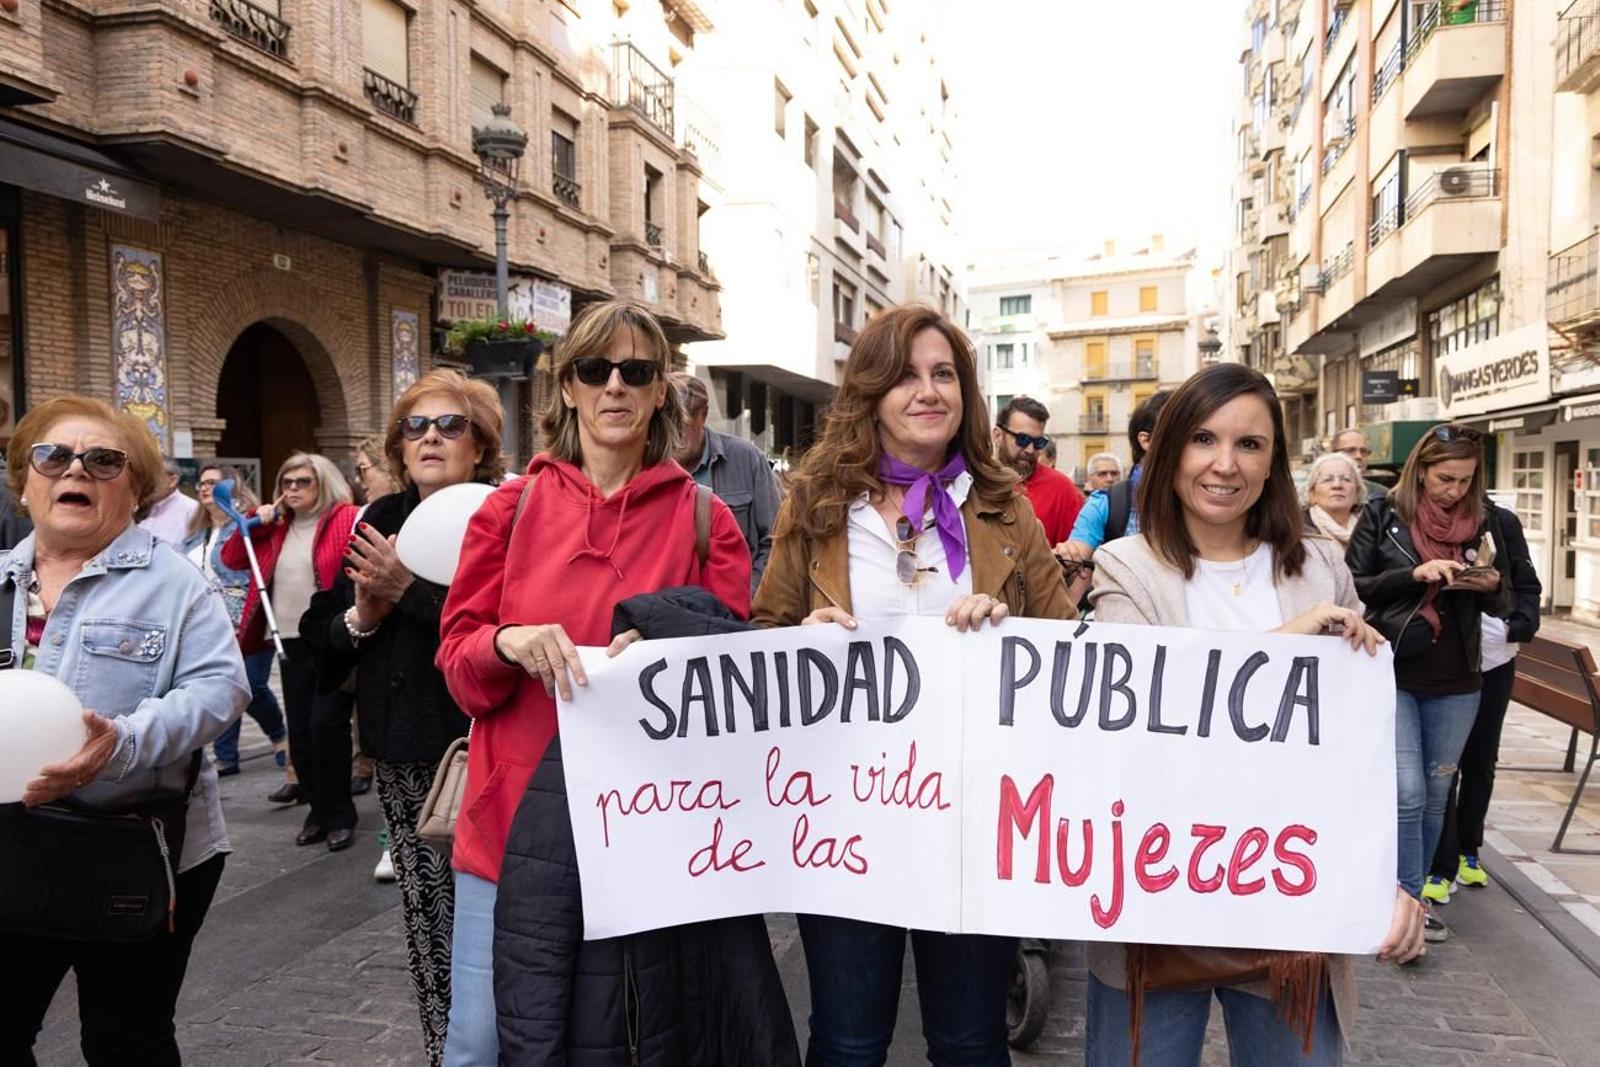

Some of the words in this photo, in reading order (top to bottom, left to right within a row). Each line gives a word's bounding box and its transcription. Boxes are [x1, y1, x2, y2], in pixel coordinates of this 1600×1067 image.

[447, 286, 499, 300] CABALLERO
[638, 636, 921, 741] SANIDAD
[999, 623, 1320, 746] PÚBLICA
[597, 780, 741, 848] para
[766, 747, 831, 807] la
[850, 741, 950, 810] vida
[689, 817, 765, 877] de
[792, 814, 868, 875] las
[997, 773, 1318, 930] Mujeres
